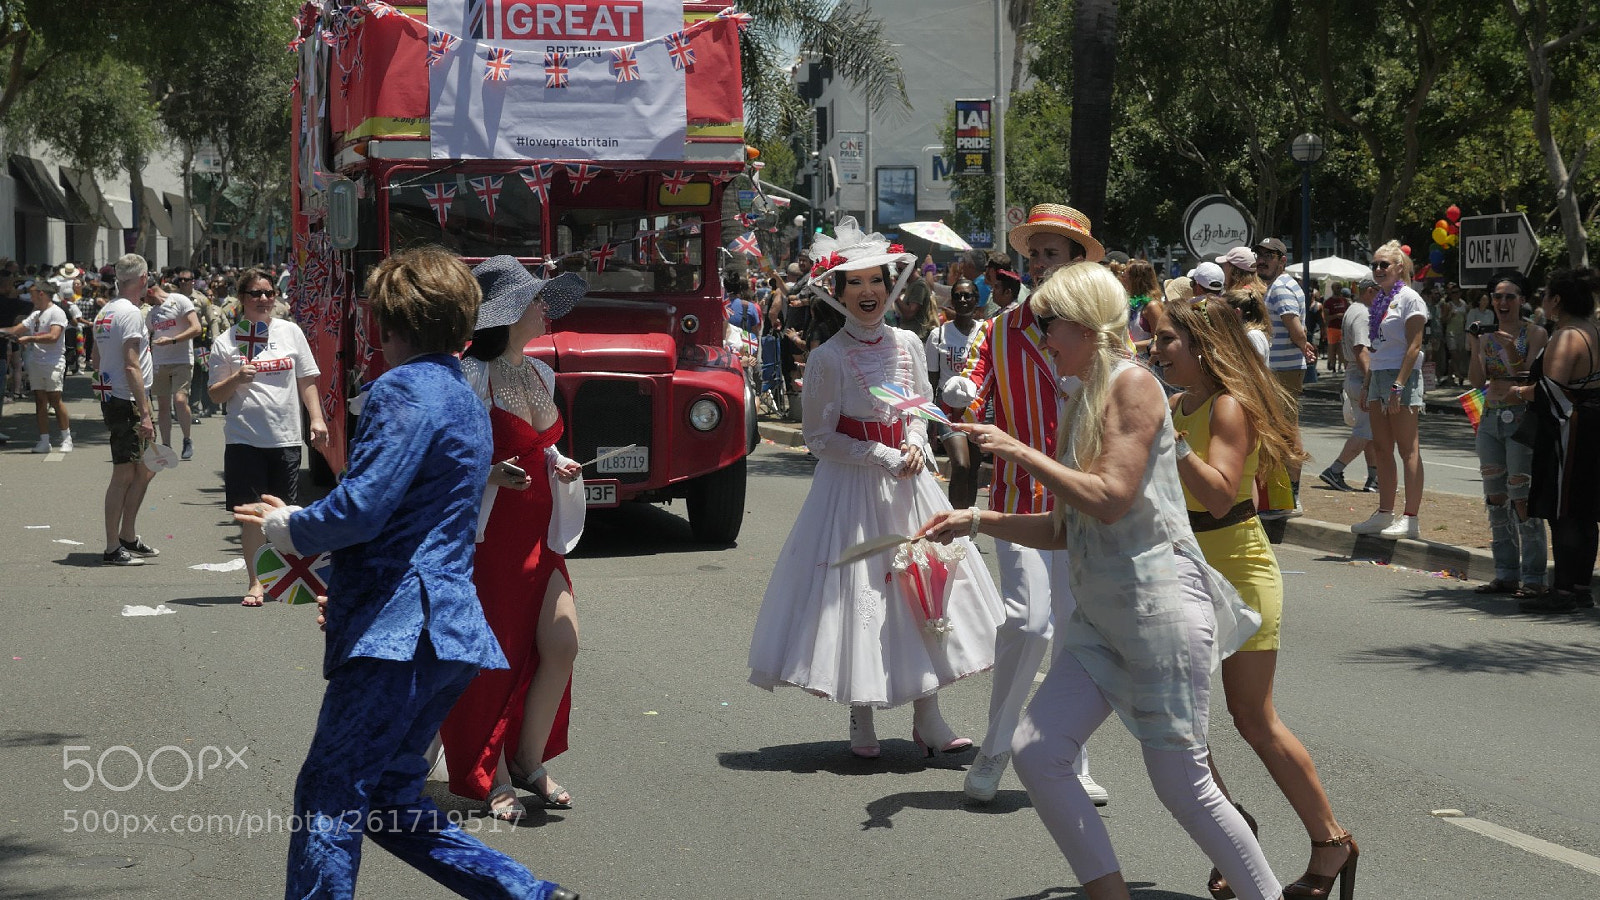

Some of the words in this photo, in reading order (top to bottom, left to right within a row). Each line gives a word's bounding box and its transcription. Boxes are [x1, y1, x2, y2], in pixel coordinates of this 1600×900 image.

[506, 3, 638, 37] GREAT
[546, 45, 602, 58] BRITAIN
[958, 110, 989, 130] LA!
[516, 136, 619, 148] #lovegreatbritain
[840, 141, 863, 150] ONE
[957, 137, 990, 149] PRIDE
[1468, 239, 1492, 264] ONE
[1494, 238, 1517, 263] WAY
[602, 456, 645, 470] 7L83719
